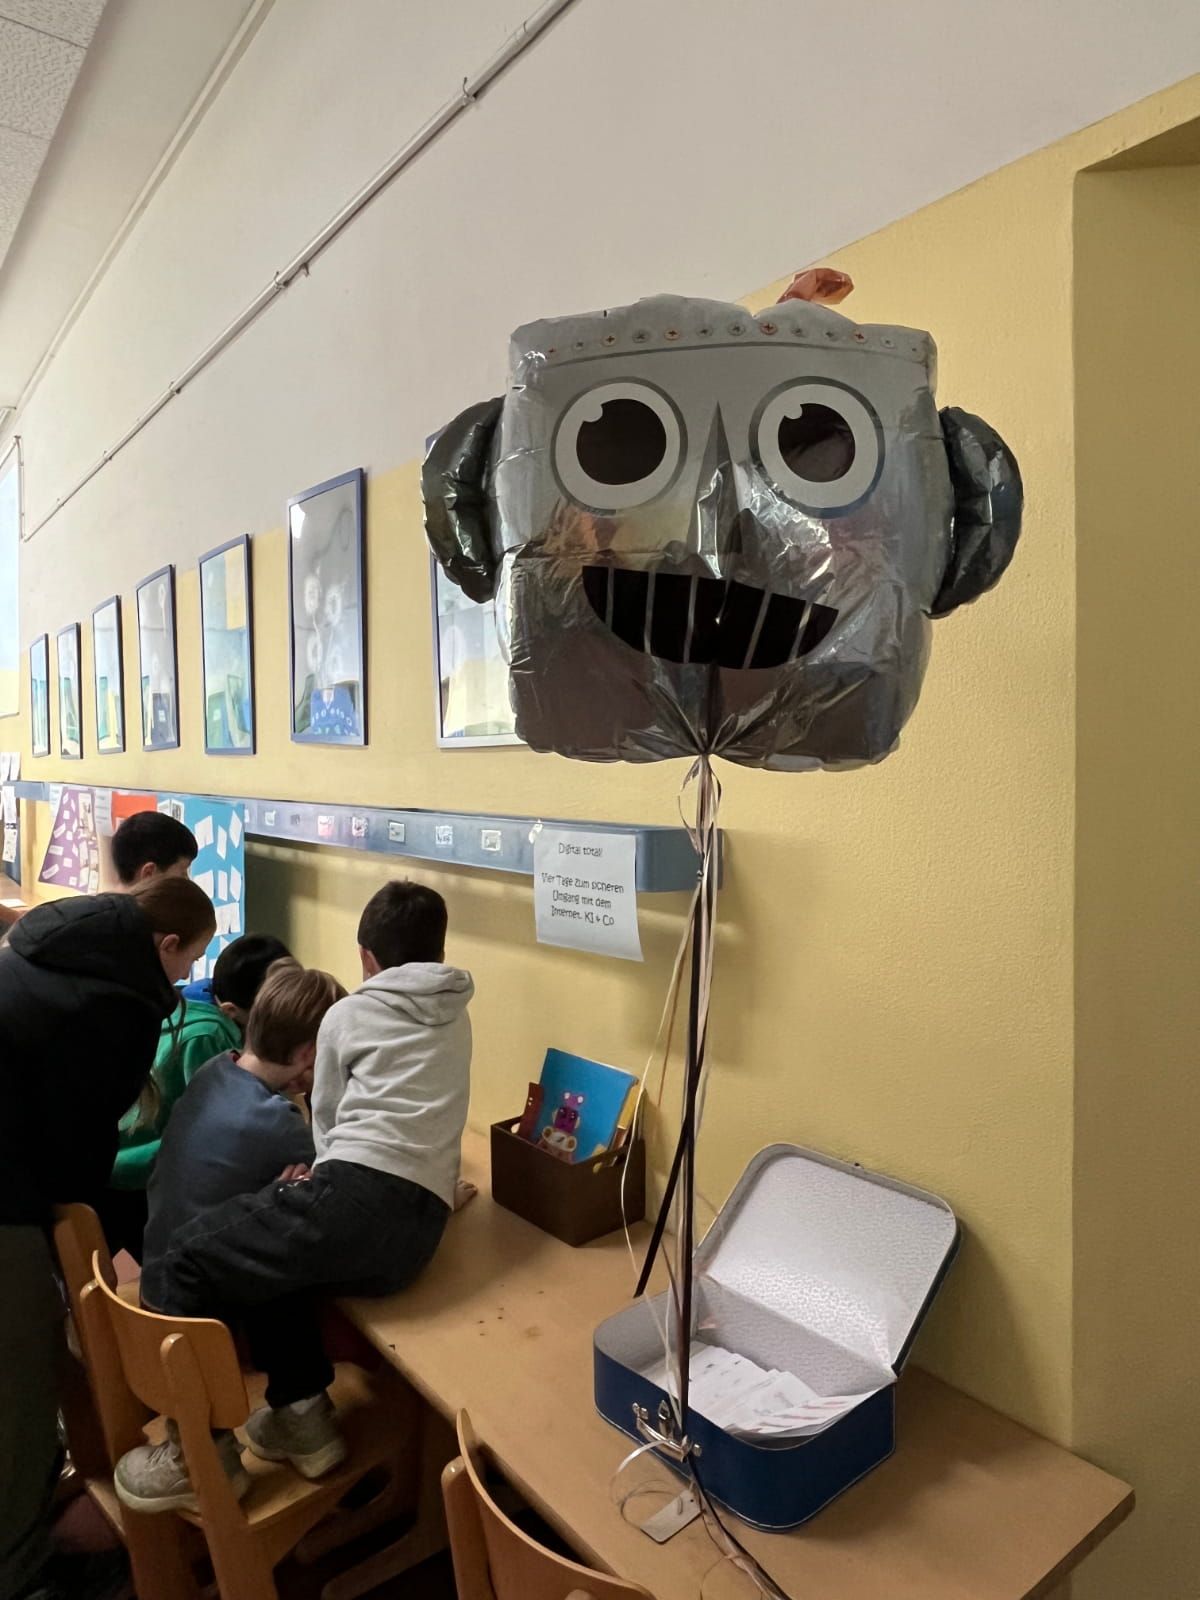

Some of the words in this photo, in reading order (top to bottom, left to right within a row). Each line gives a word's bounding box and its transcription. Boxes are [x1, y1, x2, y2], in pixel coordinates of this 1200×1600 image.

[541, 872, 555, 883] Vier
[556, 875, 573, 887] Tage
[591, 881, 624, 893] sicheren
[553, 889, 579, 904] Umgang
[581, 896, 593, 905] mit
[595, 898, 611, 909] dem
